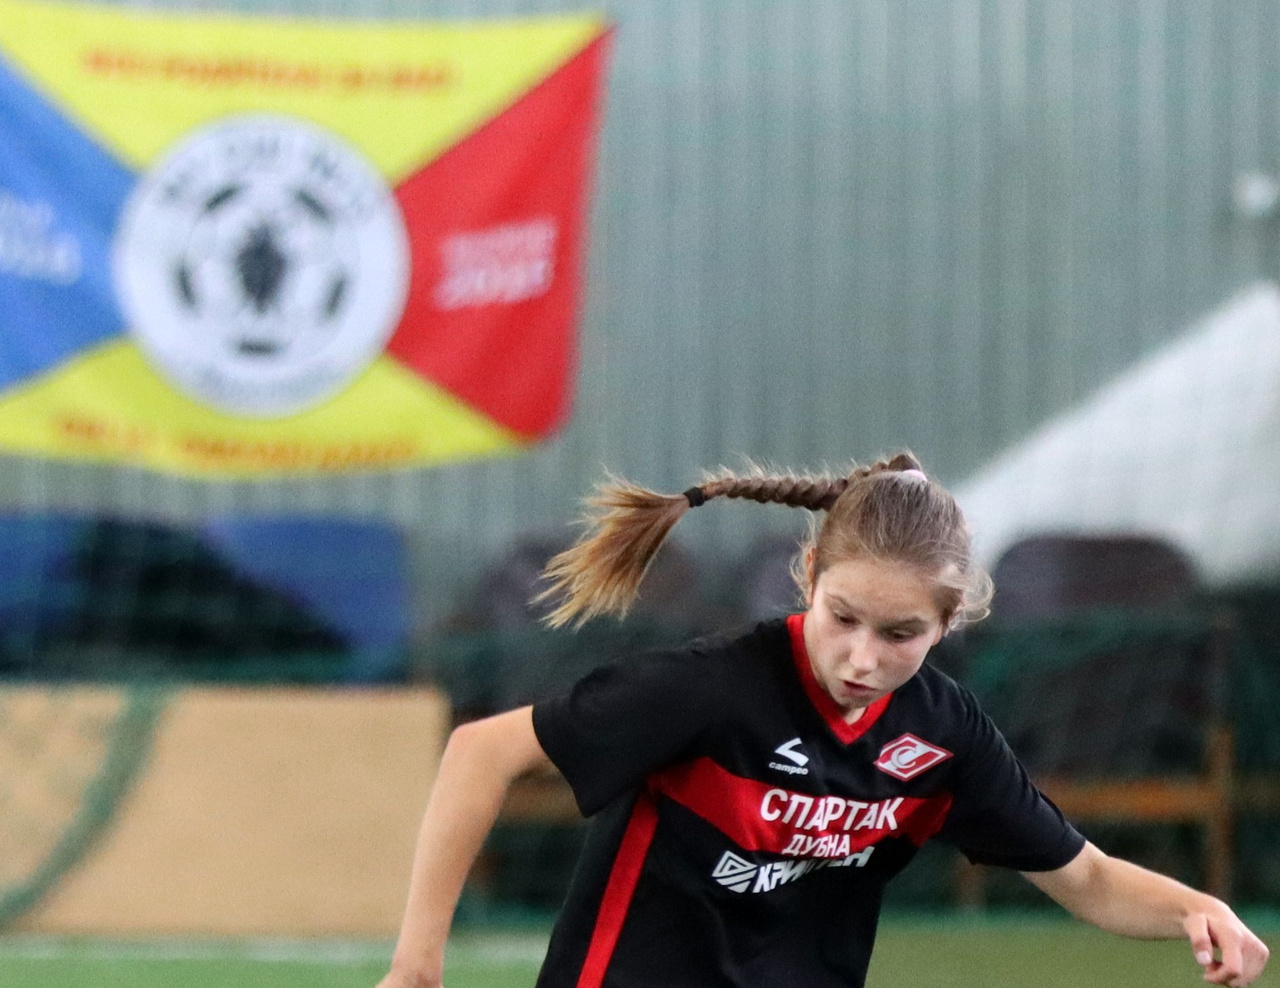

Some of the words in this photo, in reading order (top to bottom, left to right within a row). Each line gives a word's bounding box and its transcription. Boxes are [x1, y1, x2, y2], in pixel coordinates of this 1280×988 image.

[768, 761, 809, 775] campeo
[760, 789, 905, 831] СПАРТАК
[781, 834, 851, 858] ДУБНА
[752, 845, 876, 894] КРИН
